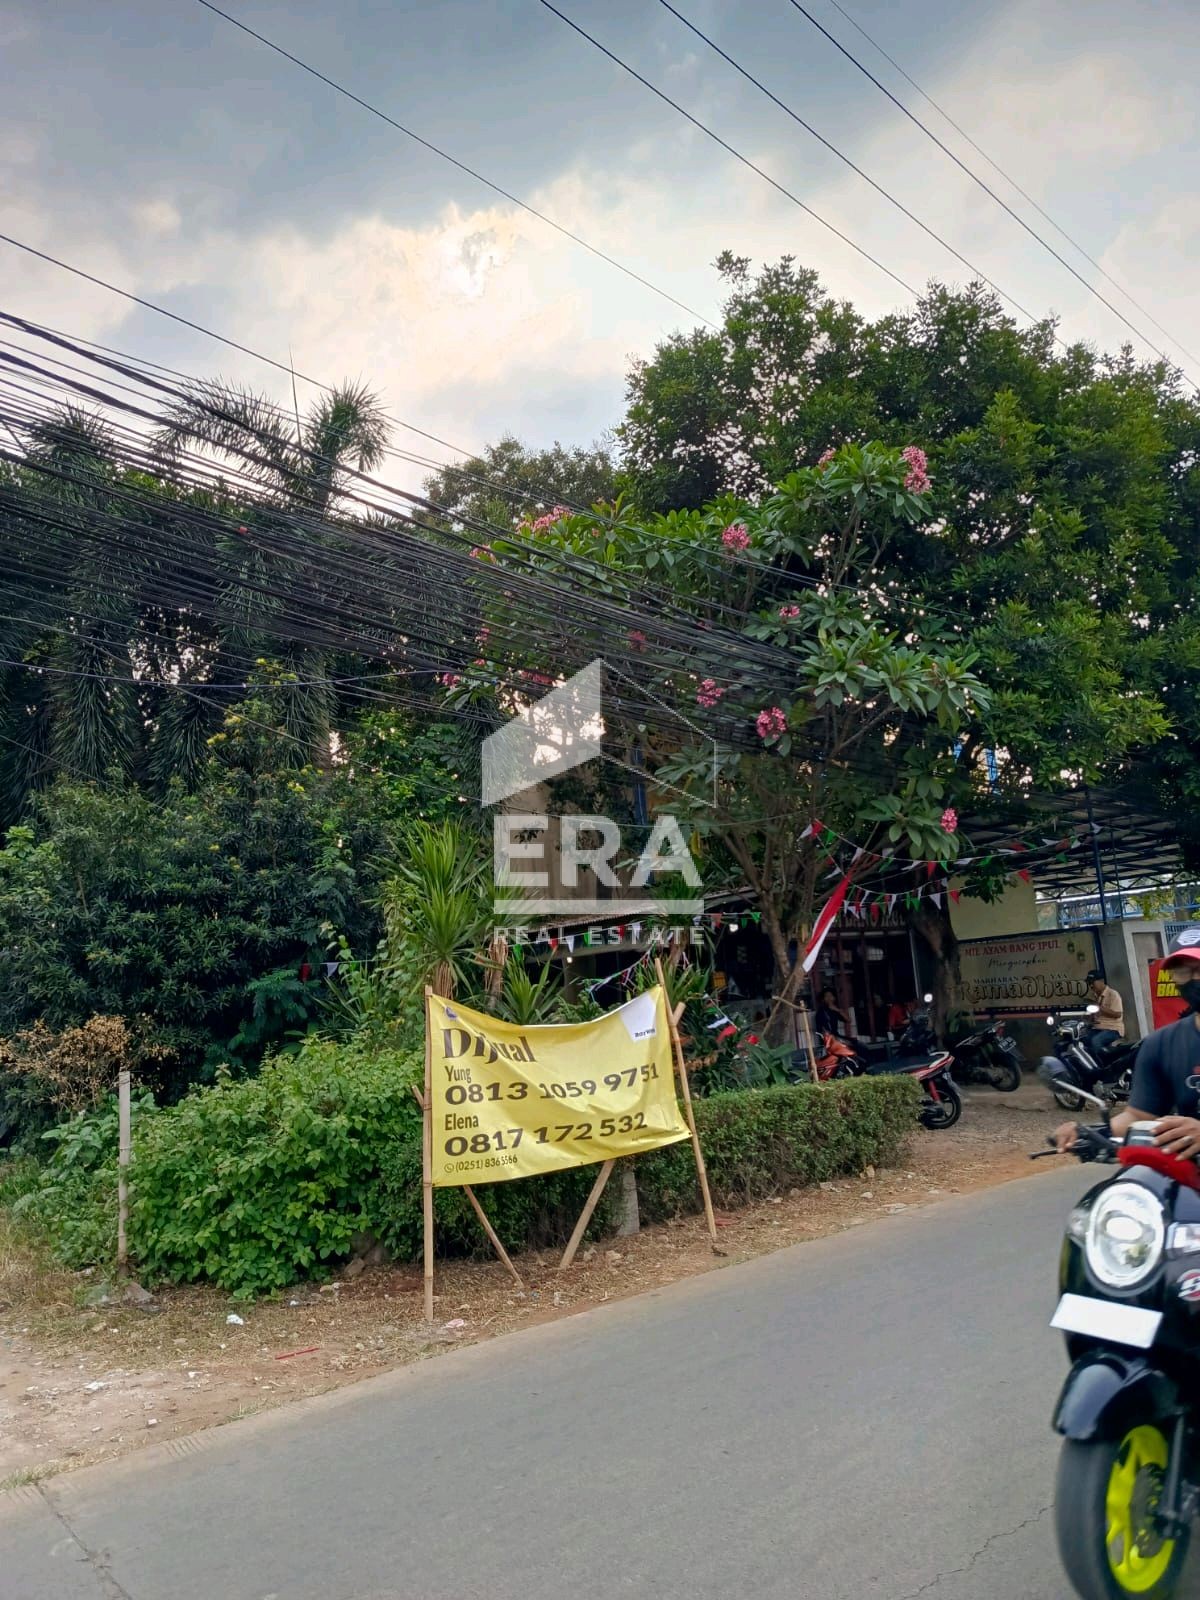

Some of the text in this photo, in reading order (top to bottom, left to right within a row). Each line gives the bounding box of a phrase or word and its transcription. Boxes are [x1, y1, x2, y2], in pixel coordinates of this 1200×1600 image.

[982, 944, 1008, 956] AYAM
[1009, 942, 1037, 953] BANG
[1038, 940, 1061, 950] IPUL
[961, 974, 1089, 1004] Ramadhan
[440, 1028, 538, 1064] Dijual
[444, 1065, 472, 1084] Yung
[445, 1062, 659, 1105] 0813 1059 9751
[444, 1112, 648, 1156] 0817 172 532
[445, 1113, 479, 1131] Elena
[455, 1159, 484, 1173] (0251)
